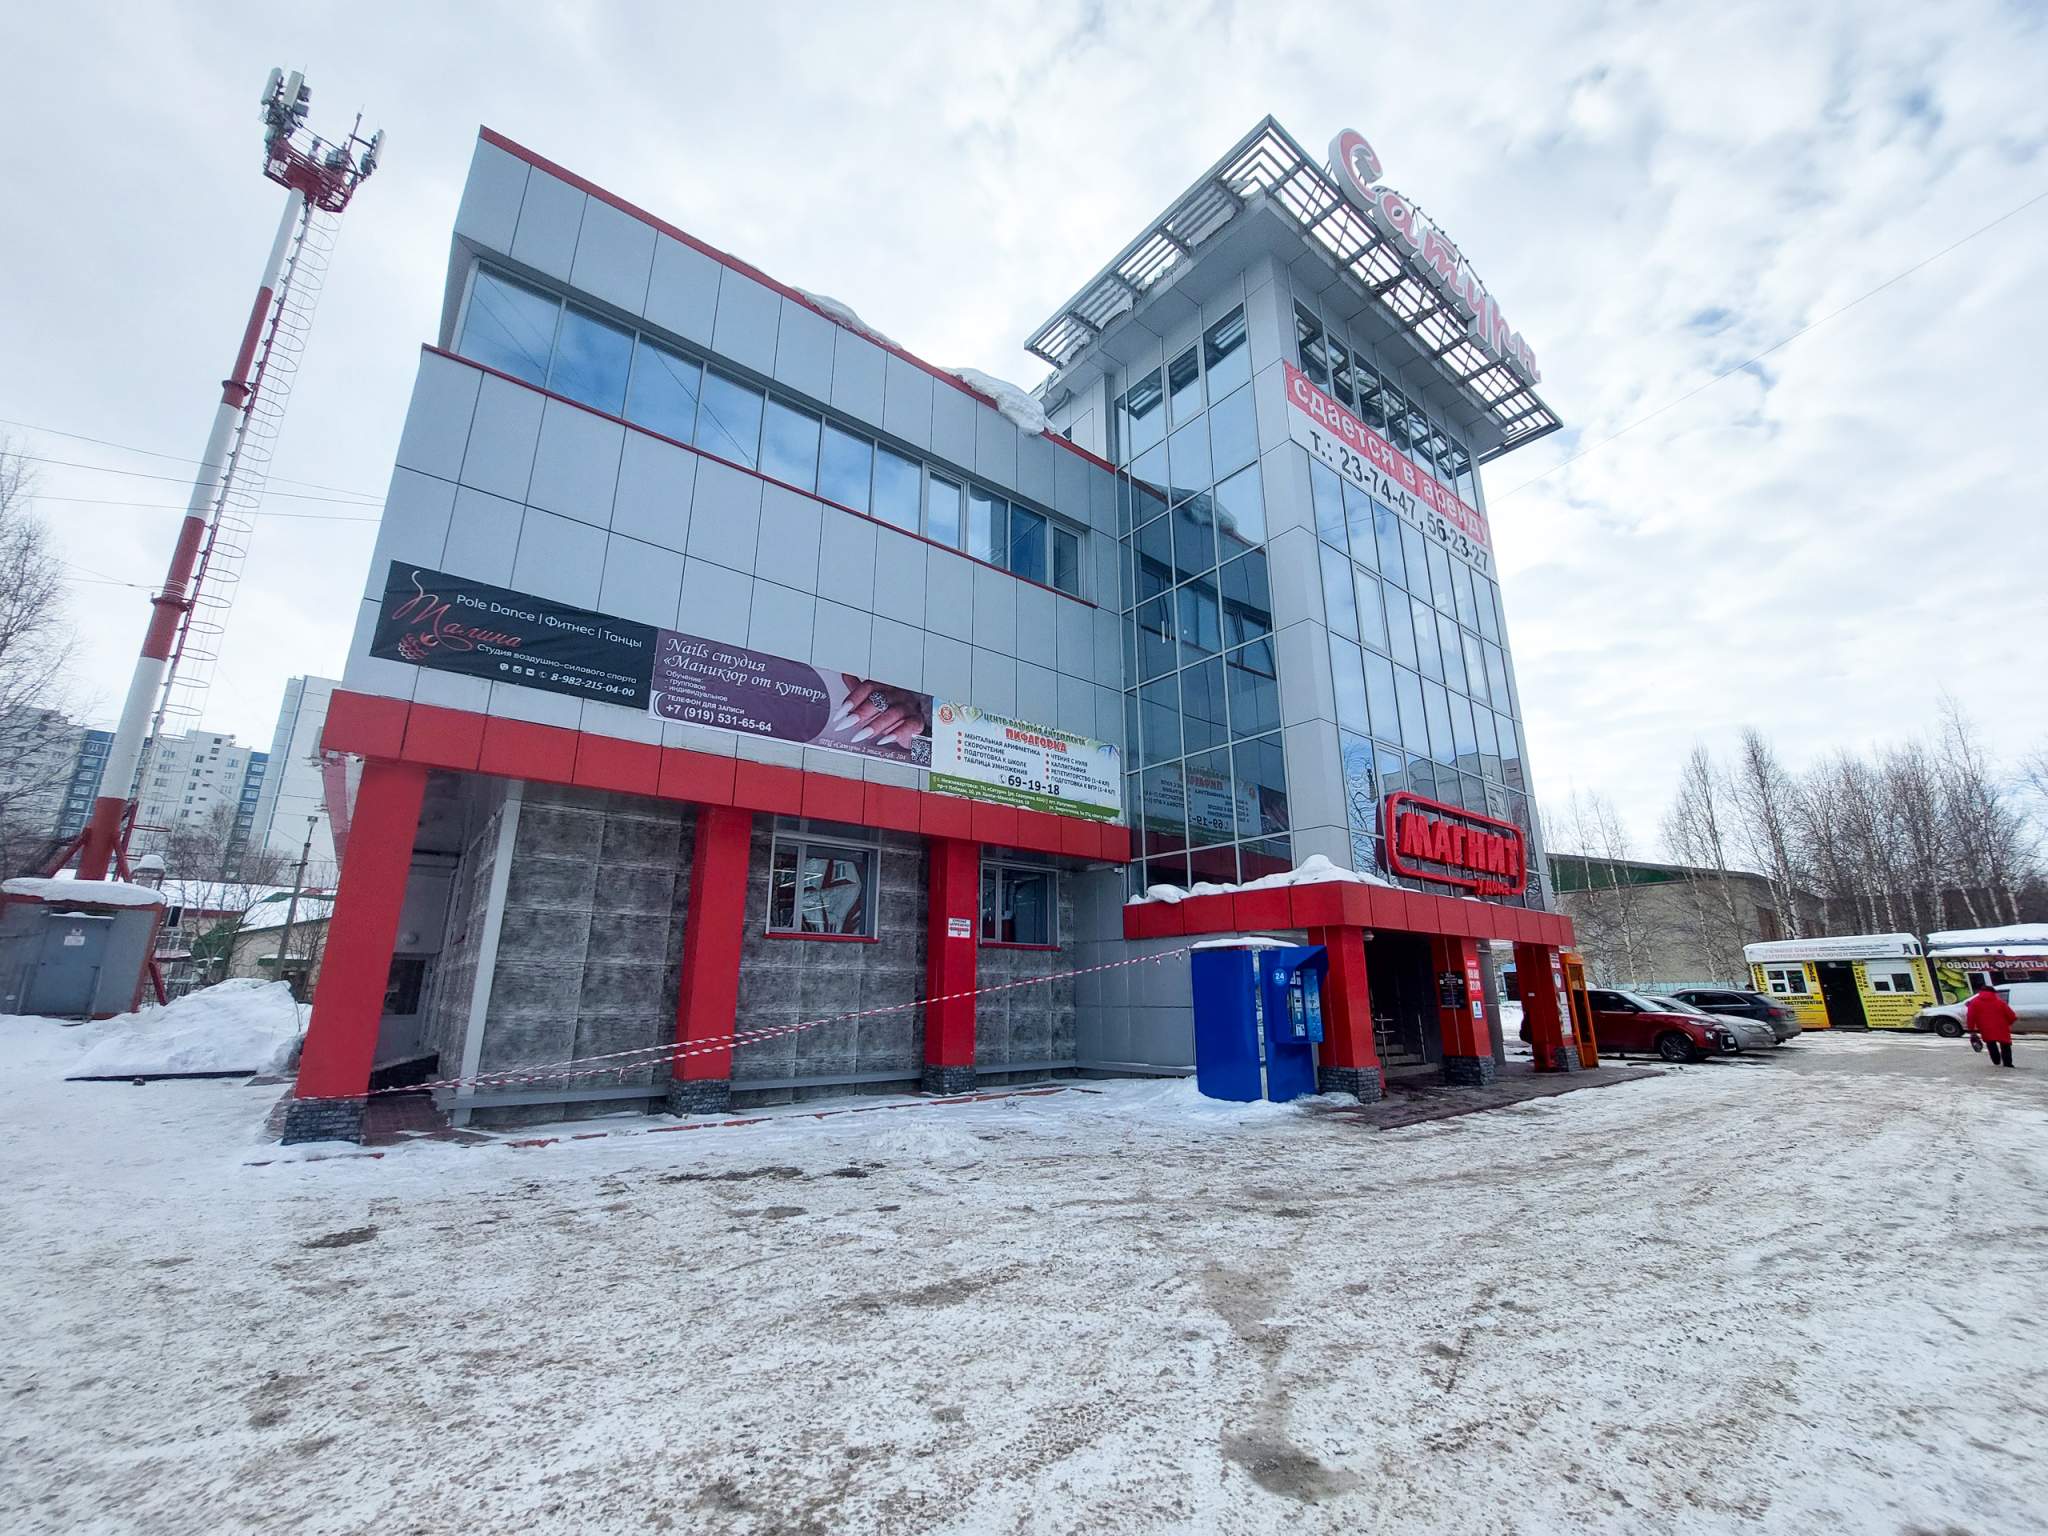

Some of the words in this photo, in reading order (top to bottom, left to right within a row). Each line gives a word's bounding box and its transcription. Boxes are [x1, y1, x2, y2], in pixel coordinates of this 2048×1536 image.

[1428, 514, 1488, 572] 56-23-27
[392, 570, 523, 650] Малина
[456, 594, 487, 610] Pole
[490, 602, 536, 622] Dance
[545, 615, 595, 636] Фитнес
[604, 630, 642, 648] Танцы
[477, 643, 512, 657] Студия
[514, 652, 604, 677] воздушно-силового
[606, 672, 637, 685] спорта
[666, 638, 709, 658] Nails
[712, 652, 766, 672] студия
[551, 672, 635, 697] 8-982-215-04-00
[751, 676, 771, 688] от
[666, 704, 681, 715] +7
[684, 706, 714, 723] (919)
[717, 713, 772, 732] 531-65-64
[667, 694, 701, 707] ТЕЛЕФОН
[718, 705, 745, 715] ЗАПИСИ
[1008, 774, 1060, 796] 69-19-18
[1399, 812, 1519, 877] МАГНИТ
